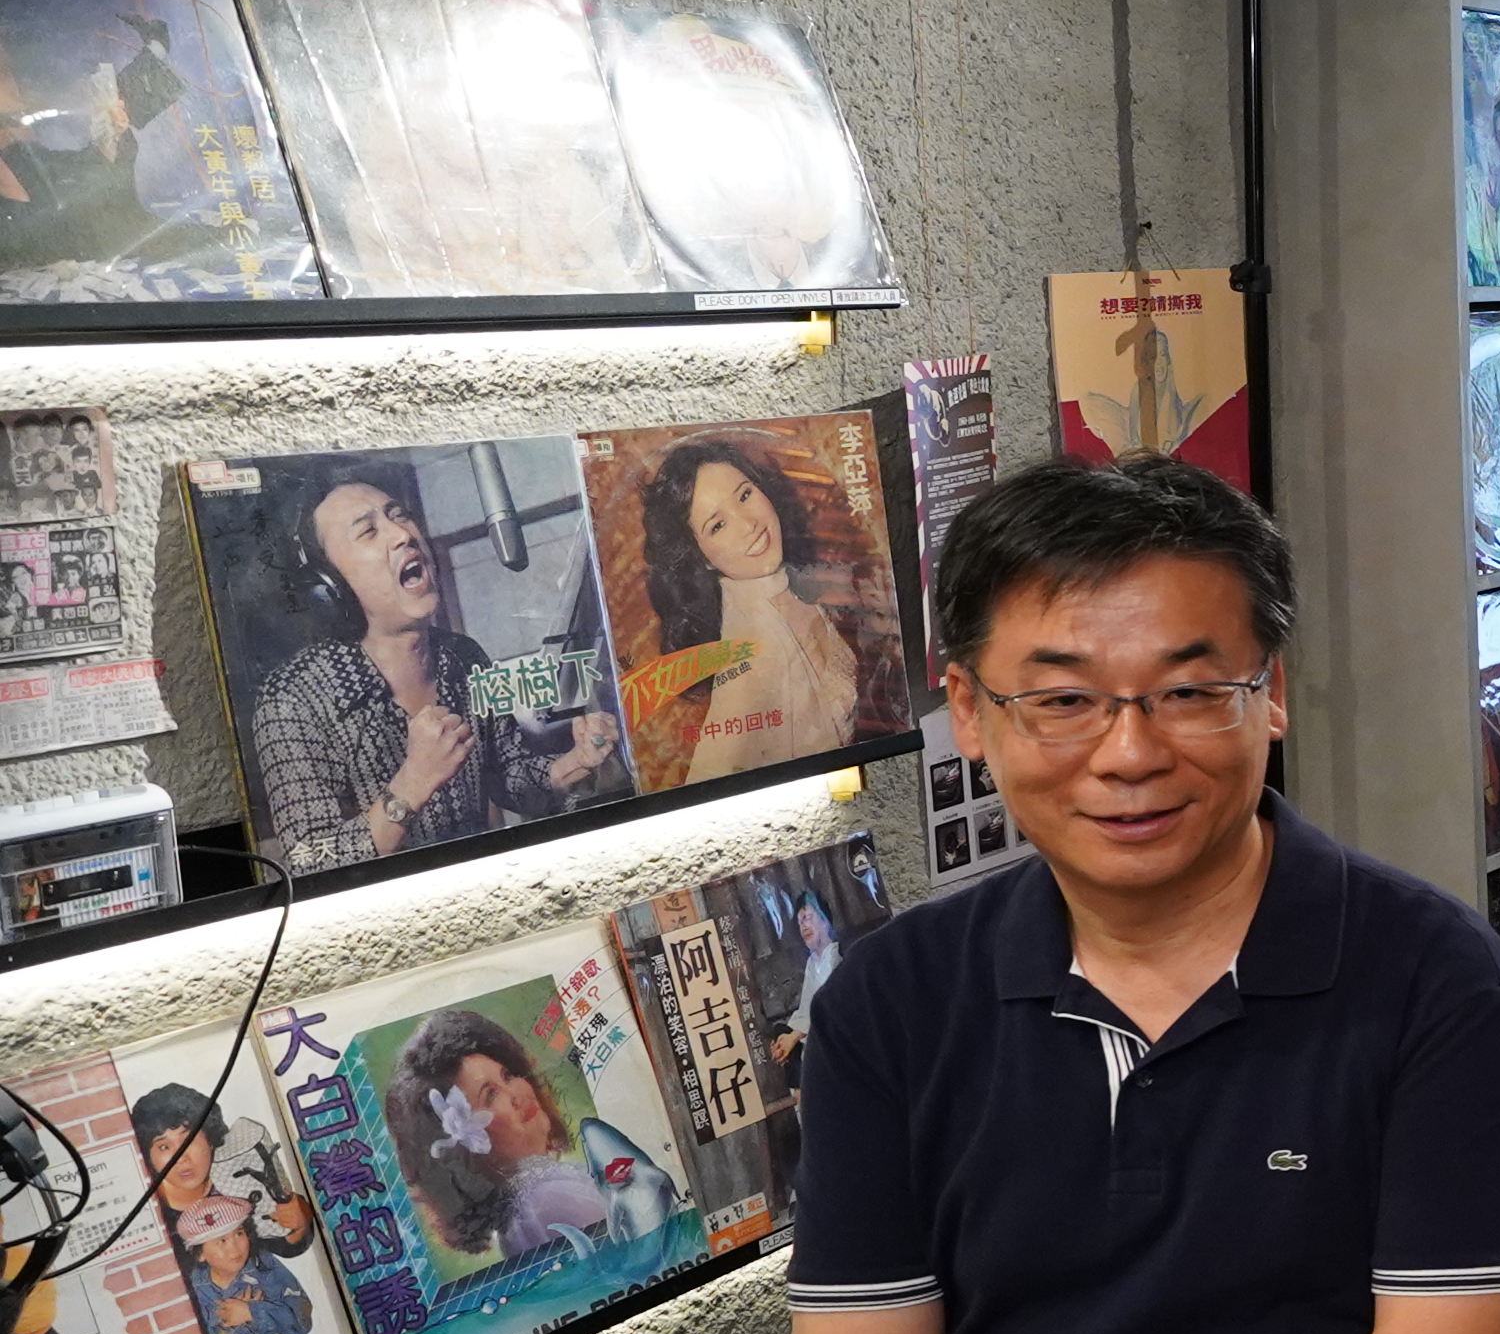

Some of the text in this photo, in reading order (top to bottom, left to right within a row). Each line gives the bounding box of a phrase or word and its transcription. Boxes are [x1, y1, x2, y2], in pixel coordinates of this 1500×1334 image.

[698, 291, 828, 307] PLEASE DON'T OPEN VINYLS
[1099, 293, 1204, 315] 想要?請撕我
[470, 650, 603, 718] 榕樹下
[681, 708, 784, 745] 雨中的回憶
[670, 929, 753, 1125] 阿吉仔
[585, 1025, 628, 1081] 大白鯊
